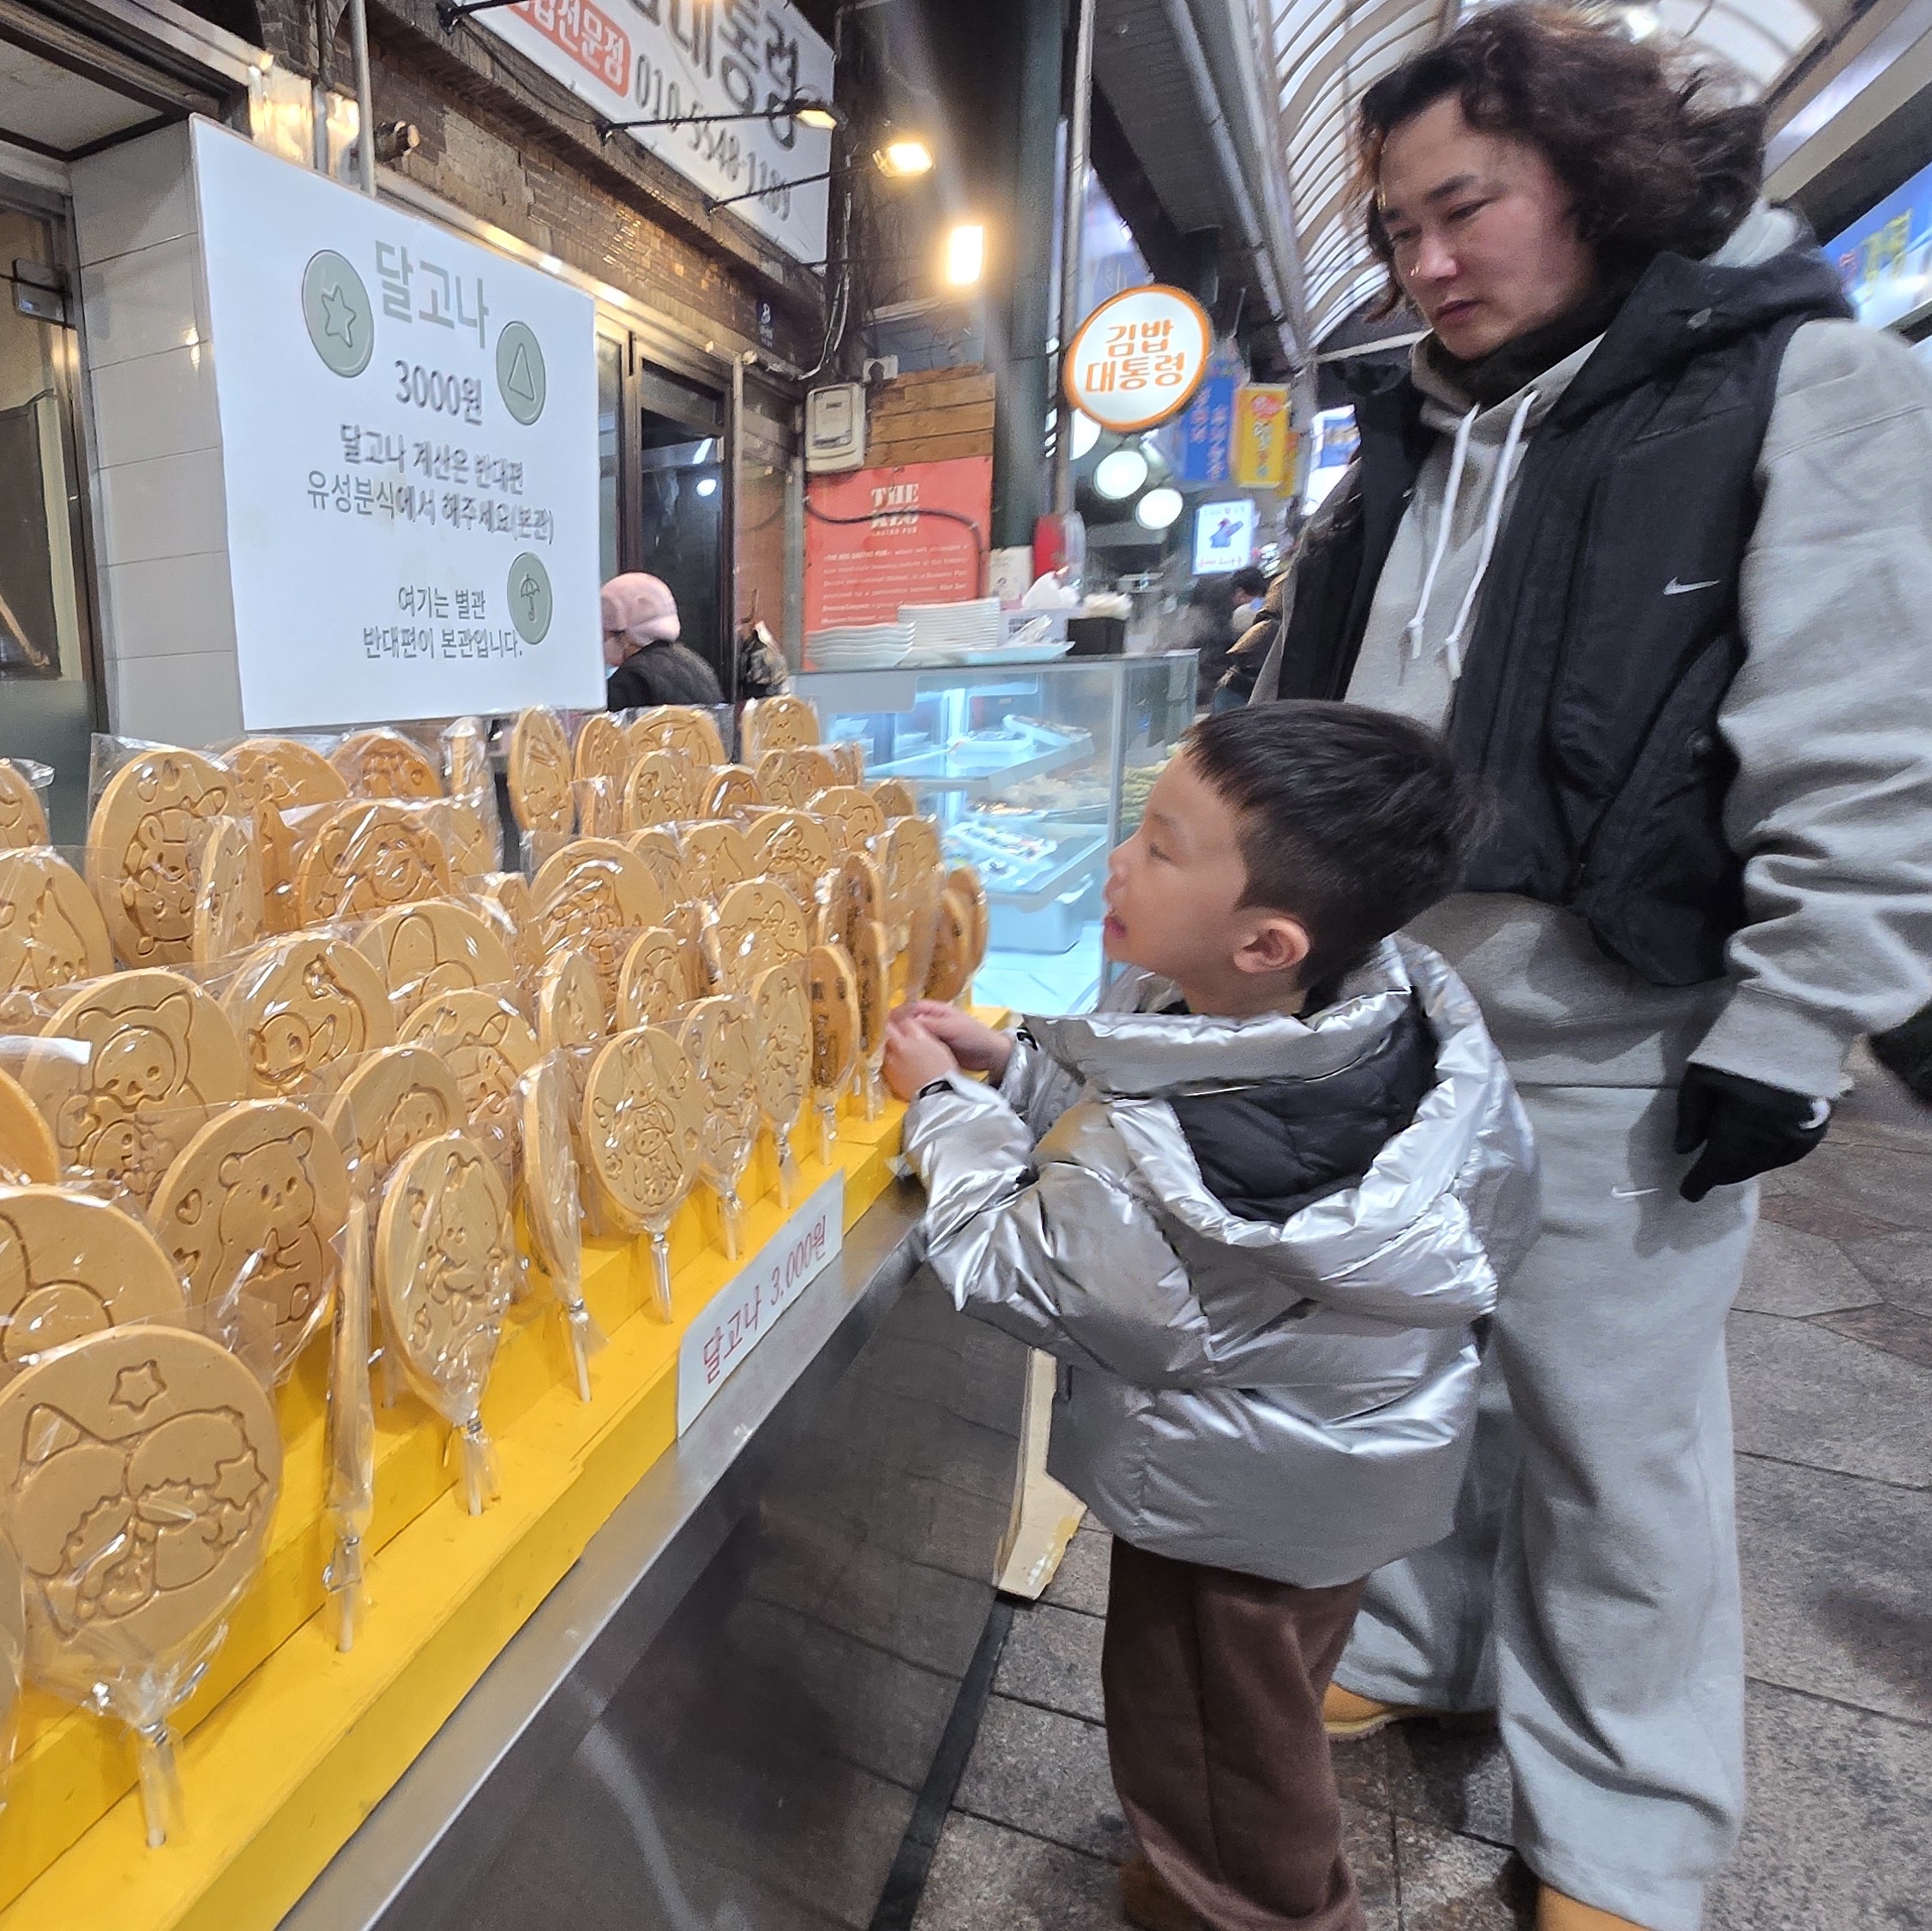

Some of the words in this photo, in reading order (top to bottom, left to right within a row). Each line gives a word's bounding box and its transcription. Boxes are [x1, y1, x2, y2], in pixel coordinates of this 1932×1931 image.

[375, 240, 490, 350] 달고나
[1105, 319, 1174, 357] 김밥
[394, 359, 482, 425] 3000원
[1086, 352, 1184, 393] 대통령
[340, 424, 406, 473] 달고나
[413, 440, 469, 484] 계산은
[474, 454, 523, 495] 반대편
[306, 470, 436, 526] 유성분식에서
[870, 484, 919, 508] THE
[399, 585, 449, 618] 여기는
[455, 589, 486, 619] 별관
[364, 625, 434, 659] 반대편이
[442, 629, 522, 659] 본관입니다.
[704, 1284, 761, 1385] 달고나
